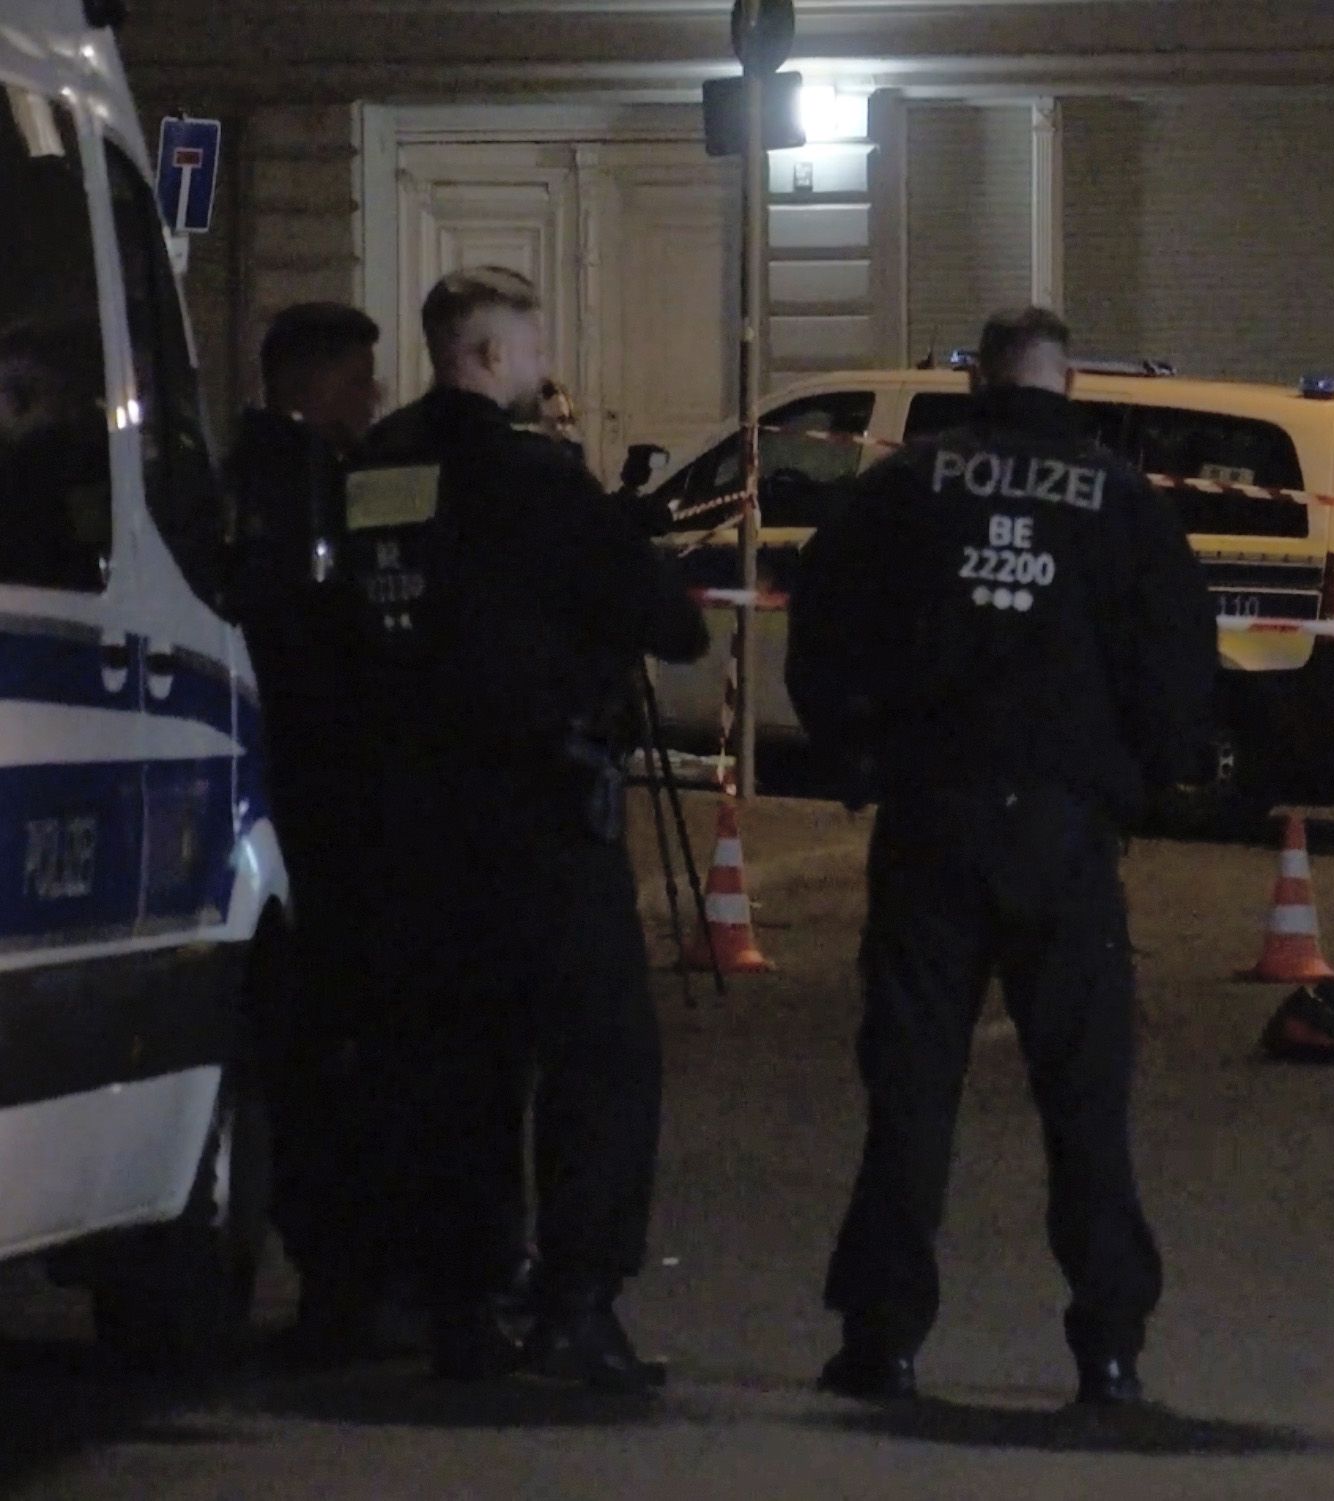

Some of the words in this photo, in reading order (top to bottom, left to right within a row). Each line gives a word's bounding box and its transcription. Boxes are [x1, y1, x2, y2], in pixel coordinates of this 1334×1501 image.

[932, 451, 1107, 511] POLIZEI
[989, 514, 1034, 549] BE
[958, 546, 1055, 586] 22200
